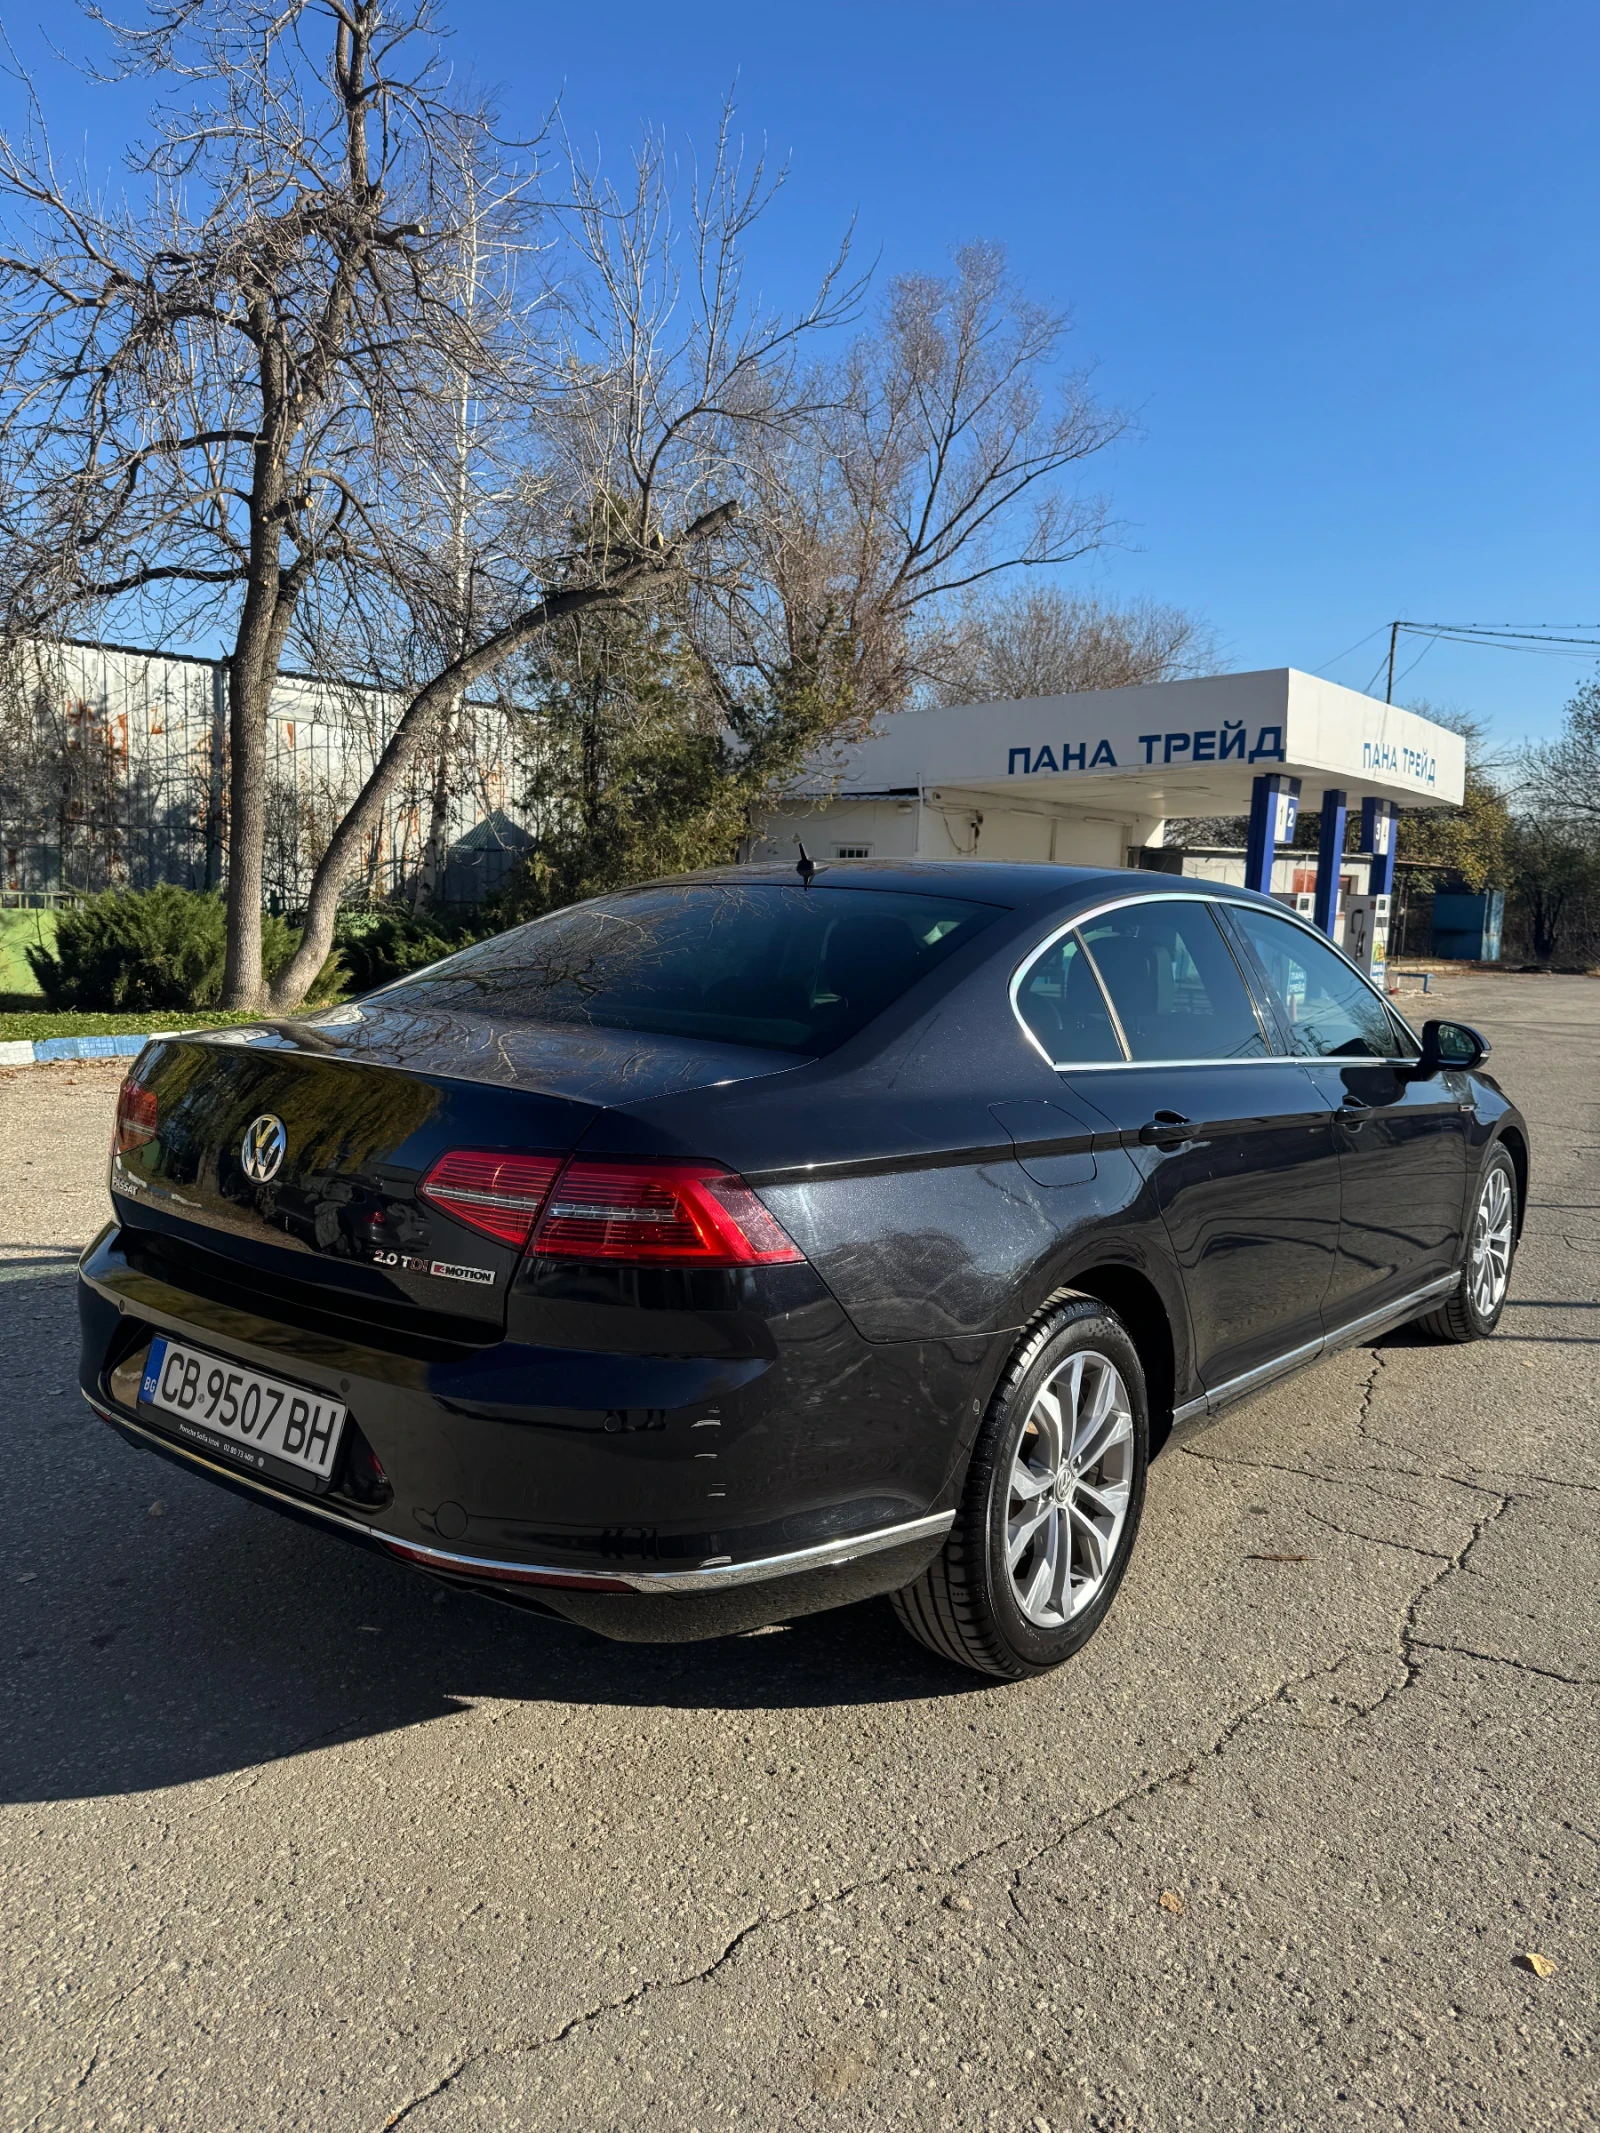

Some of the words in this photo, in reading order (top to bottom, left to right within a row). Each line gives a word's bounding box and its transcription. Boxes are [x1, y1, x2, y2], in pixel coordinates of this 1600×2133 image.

[1008, 739, 1118, 774] ПАНА
[1138, 720, 1286, 764] ТРЕЙД
[1363, 743, 1397, 772] ПАНА
[1403, 747, 1436, 788] ТРЕЙД
[1287, 807, 1295, 828] 2
[1375, 823, 1381, 841] 3
[112, 1176, 138, 1196] PASSAT
[373, 1250, 398, 1266] 2.0
[401, 1255, 429, 1272] TDI
[439, 1265, 492, 1282] 4MOTION
[143, 1376, 157, 1393] BG
[161, 1352, 201, 1410] CB
[204, 1369, 285, 1440] 9507
[282, 1397, 337, 1466] BH
[179, 1424, 196, 1437] Porsche
[196, 1431, 208, 1443] Sofia
